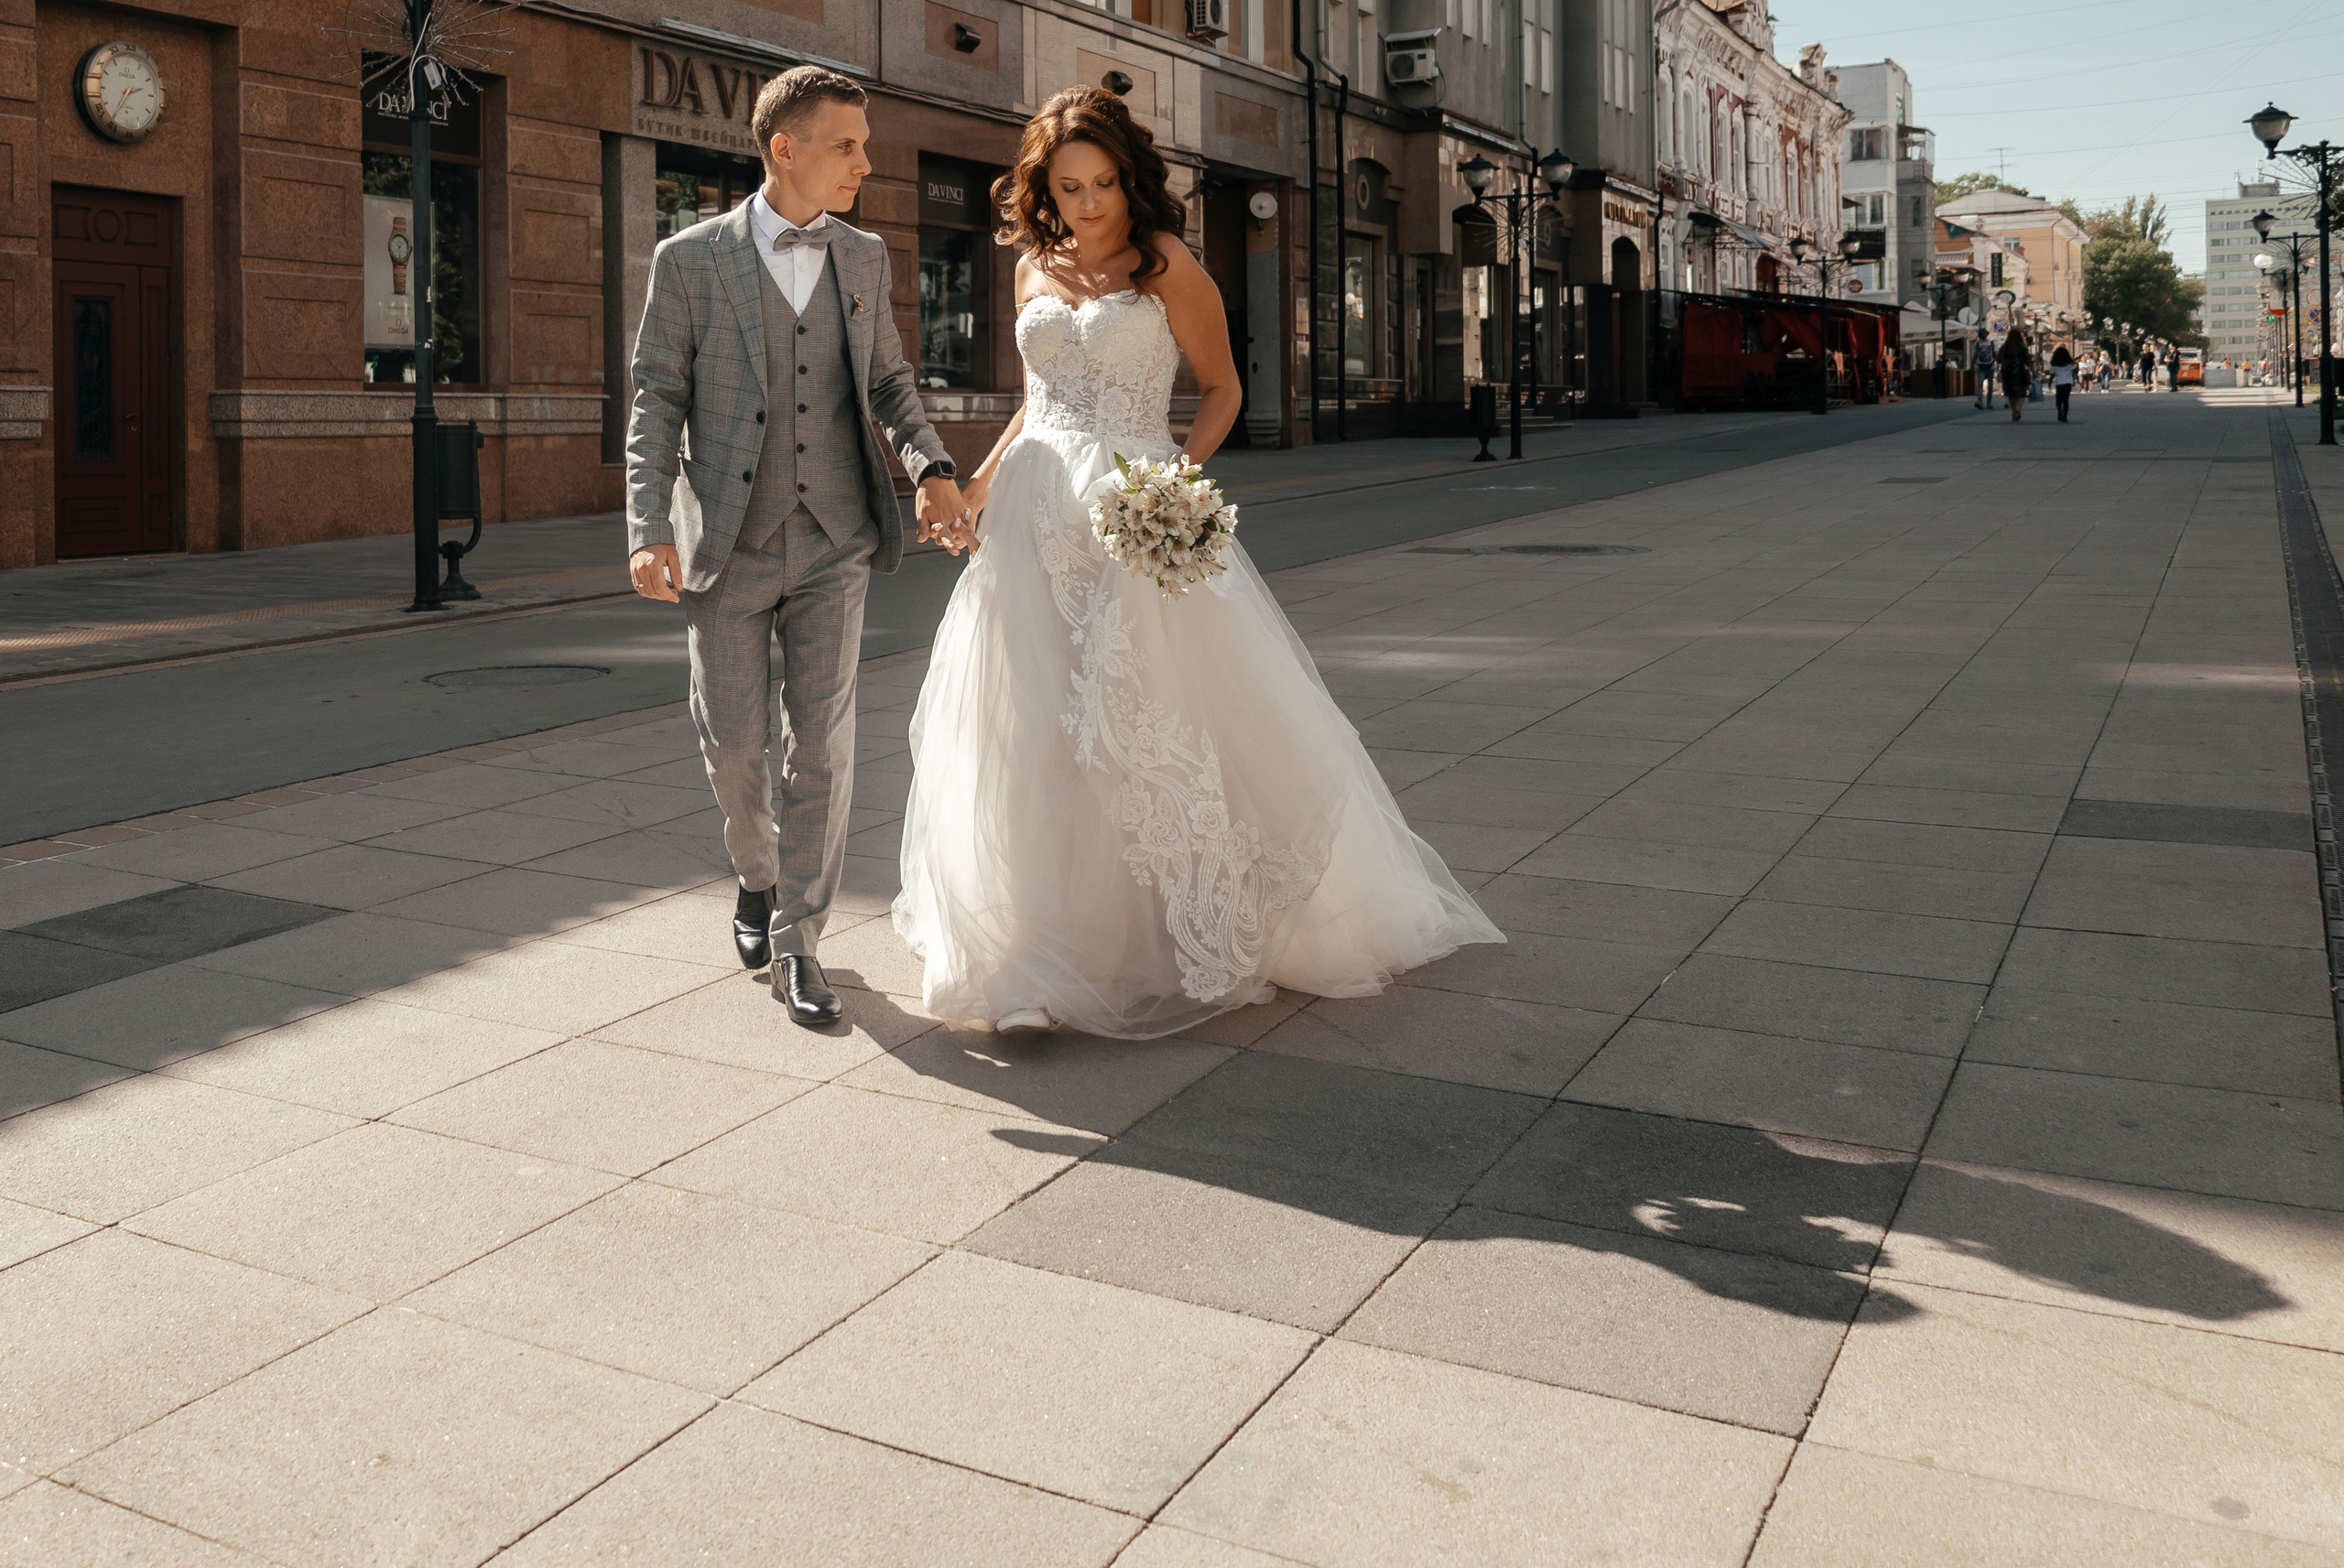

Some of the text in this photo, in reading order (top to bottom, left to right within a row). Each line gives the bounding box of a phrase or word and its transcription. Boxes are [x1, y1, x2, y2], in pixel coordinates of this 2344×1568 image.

[640, 48, 771, 125] DA VI
[637, 118, 758, 149] БУТИК ШВЕЙЦАР
[939, 185, 964, 201] VINCI
[387, 326, 409, 335] OMEGA
